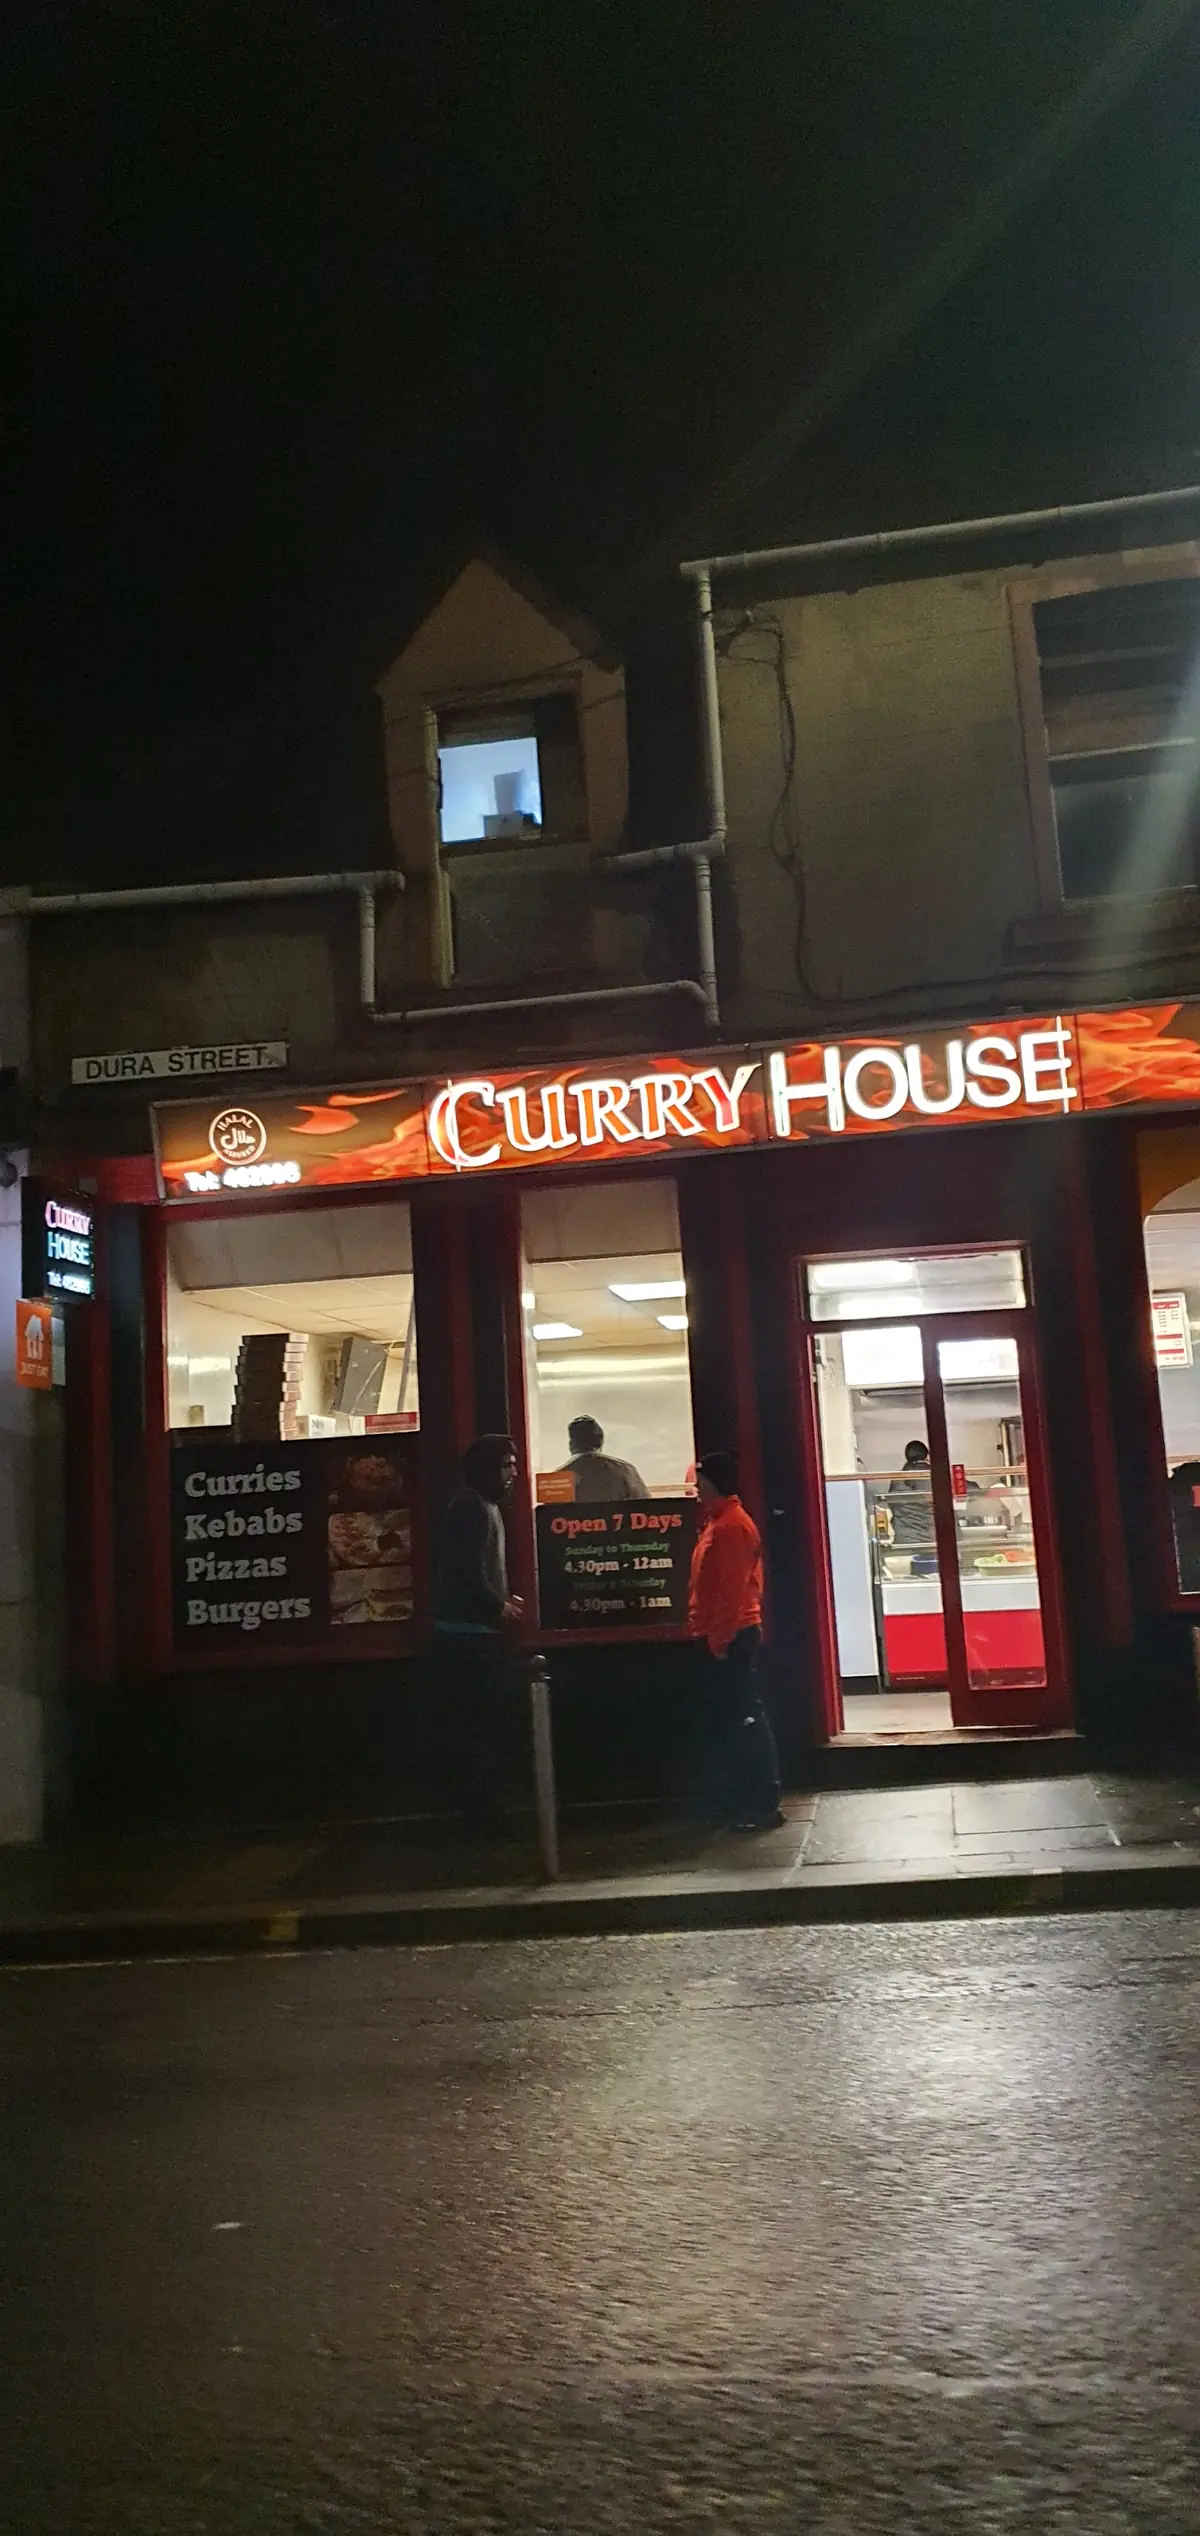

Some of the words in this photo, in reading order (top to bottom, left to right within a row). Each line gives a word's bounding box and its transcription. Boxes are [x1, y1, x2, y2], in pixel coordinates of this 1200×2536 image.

[86, 1056, 155, 1080] DURA
[769, 1030, 1078, 1137] HOUSE
[216, 1114, 254, 1131] HALAL
[47, 1231, 90, 1266] HOUSE
[184, 1464, 301, 1498] Curries
[184, 1507, 303, 1540] Kebabs
[551, 1517, 607, 1538] Open
[612, 1514, 624, 1531] 7
[630, 1512, 683, 1533] Days
[185, 1552, 288, 1582] Pizzas
[563, 1560, 620, 1576] 4.30pm
[632, 1556, 673, 1570] 12am
[186, 1598, 312, 1631] Burgers
[640, 1596, 673, 1609] 1am
